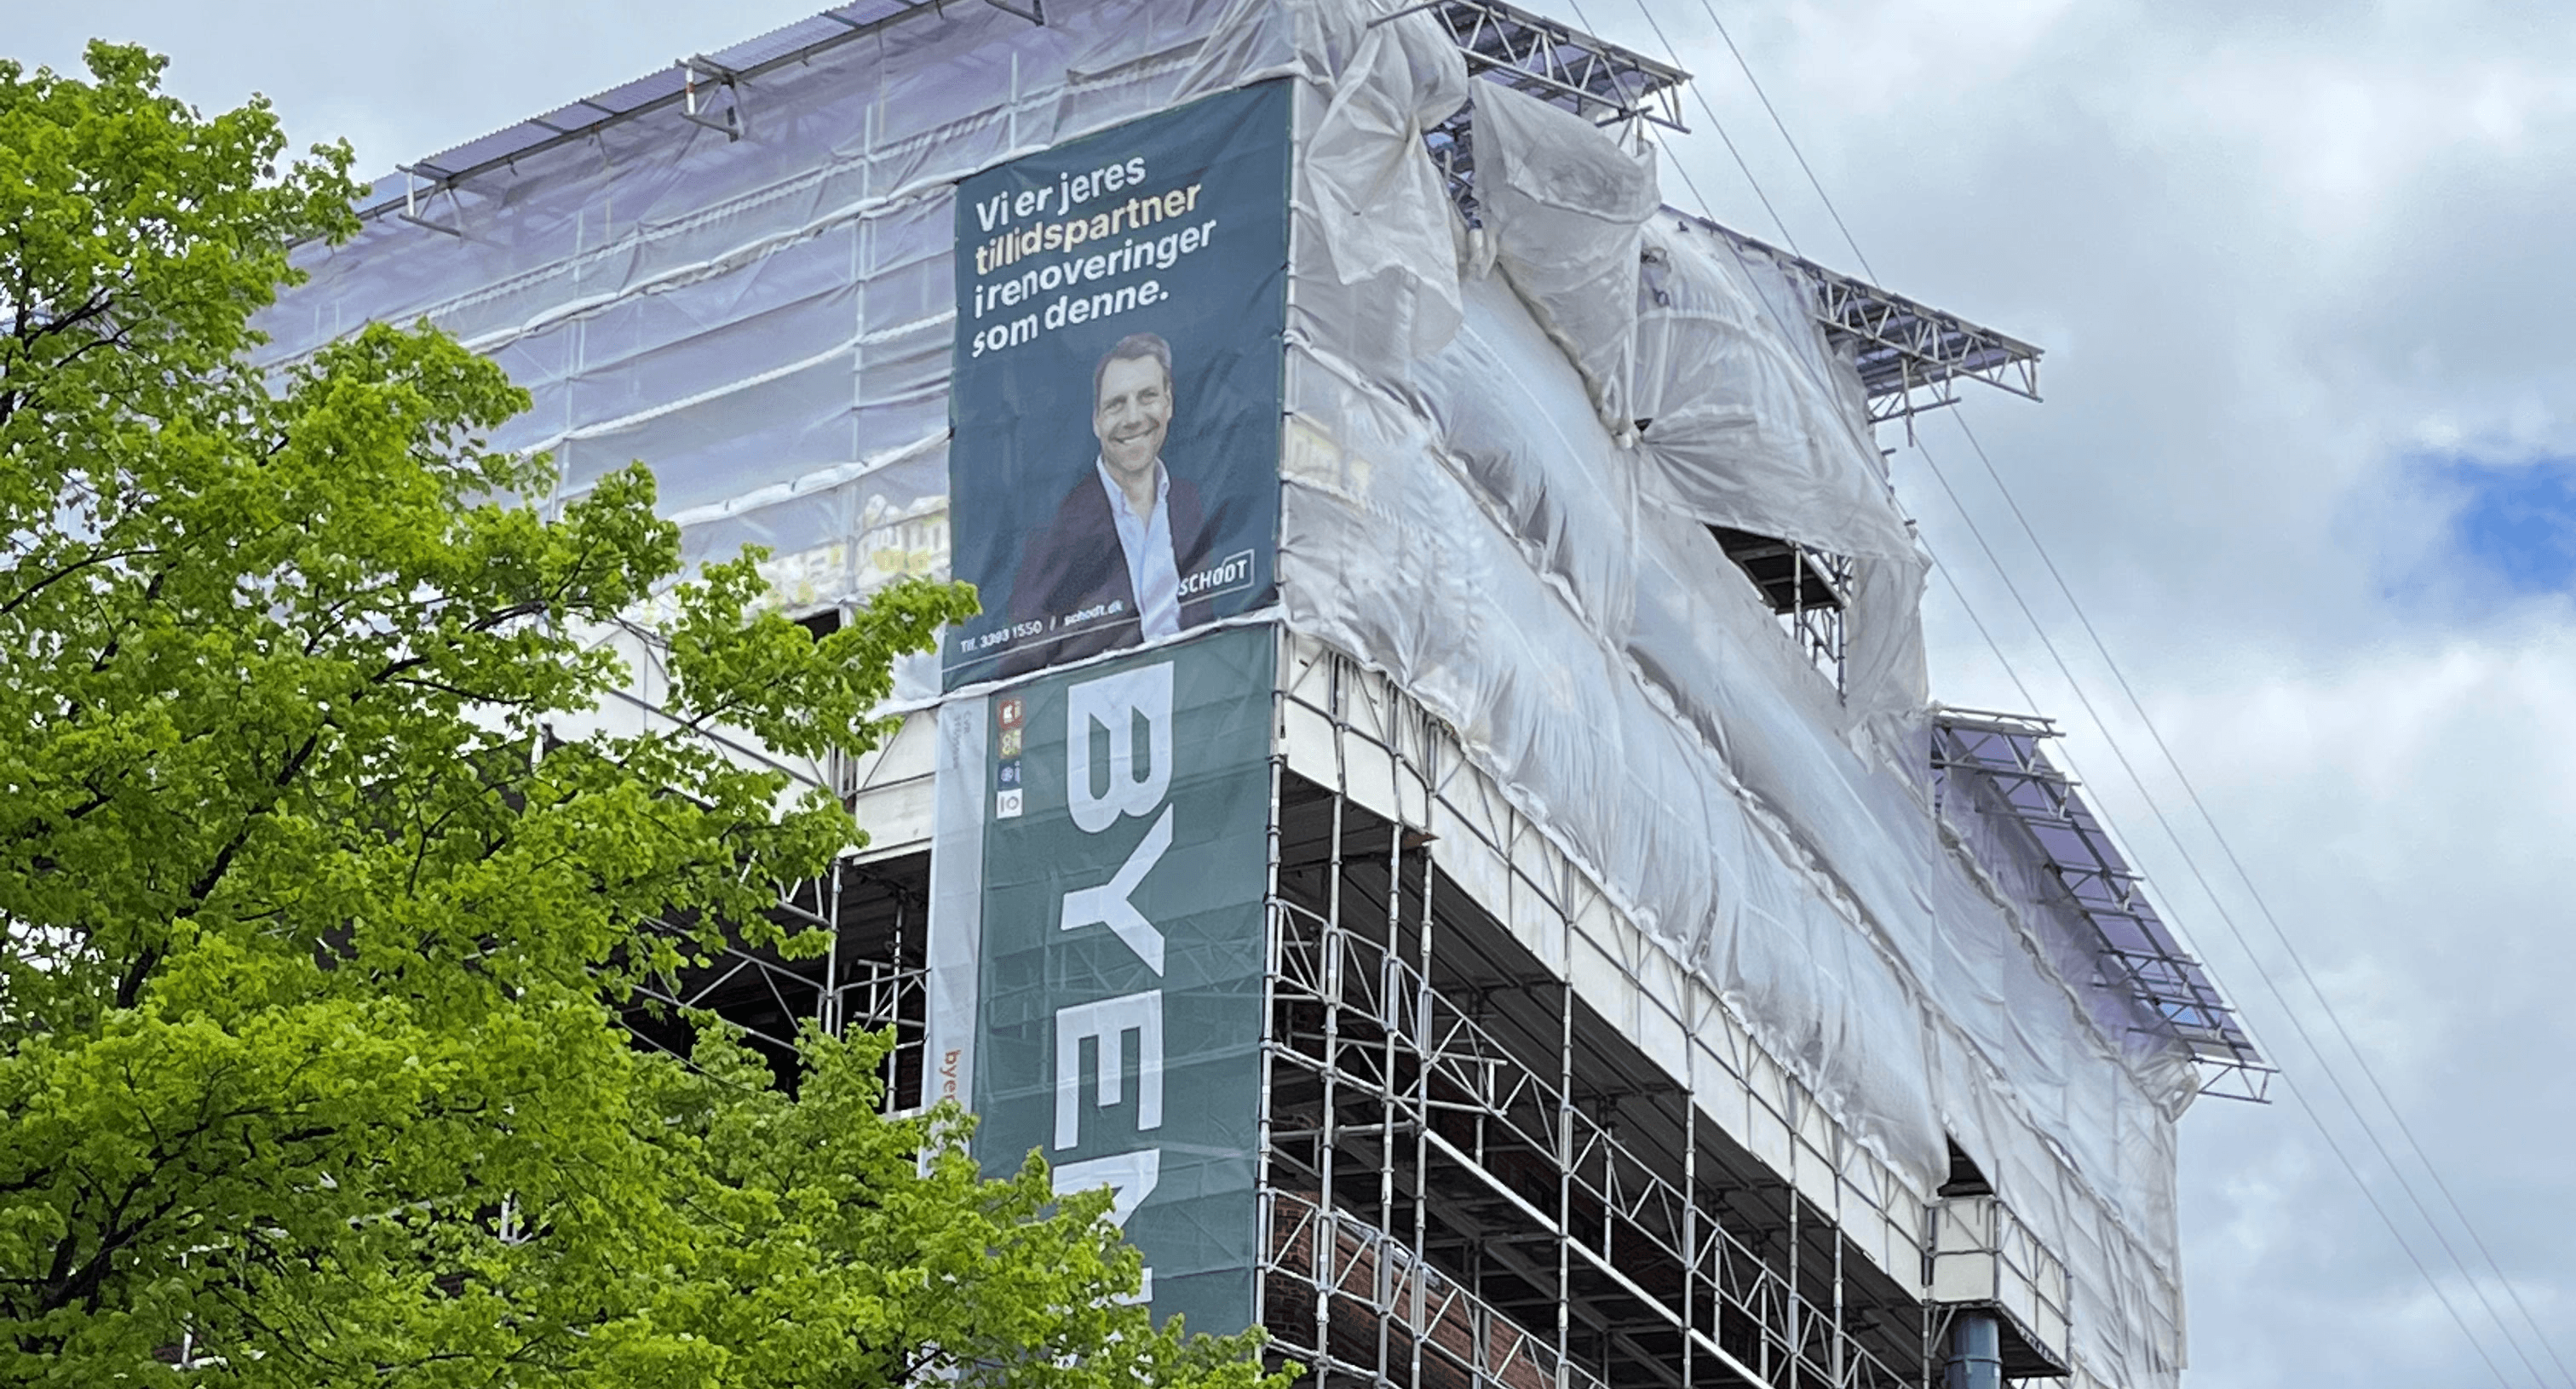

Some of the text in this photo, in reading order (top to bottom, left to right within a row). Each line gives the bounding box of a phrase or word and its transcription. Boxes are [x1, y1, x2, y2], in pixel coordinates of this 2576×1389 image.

[975, 183, 1202, 275] tillidspartner
[976, 157, 1146, 232] Vi er jeres
[975, 219, 1216, 319] i renoveringer
[971, 279, 1169, 358] som denne.
[1012, 620, 1044, 639] 1550
